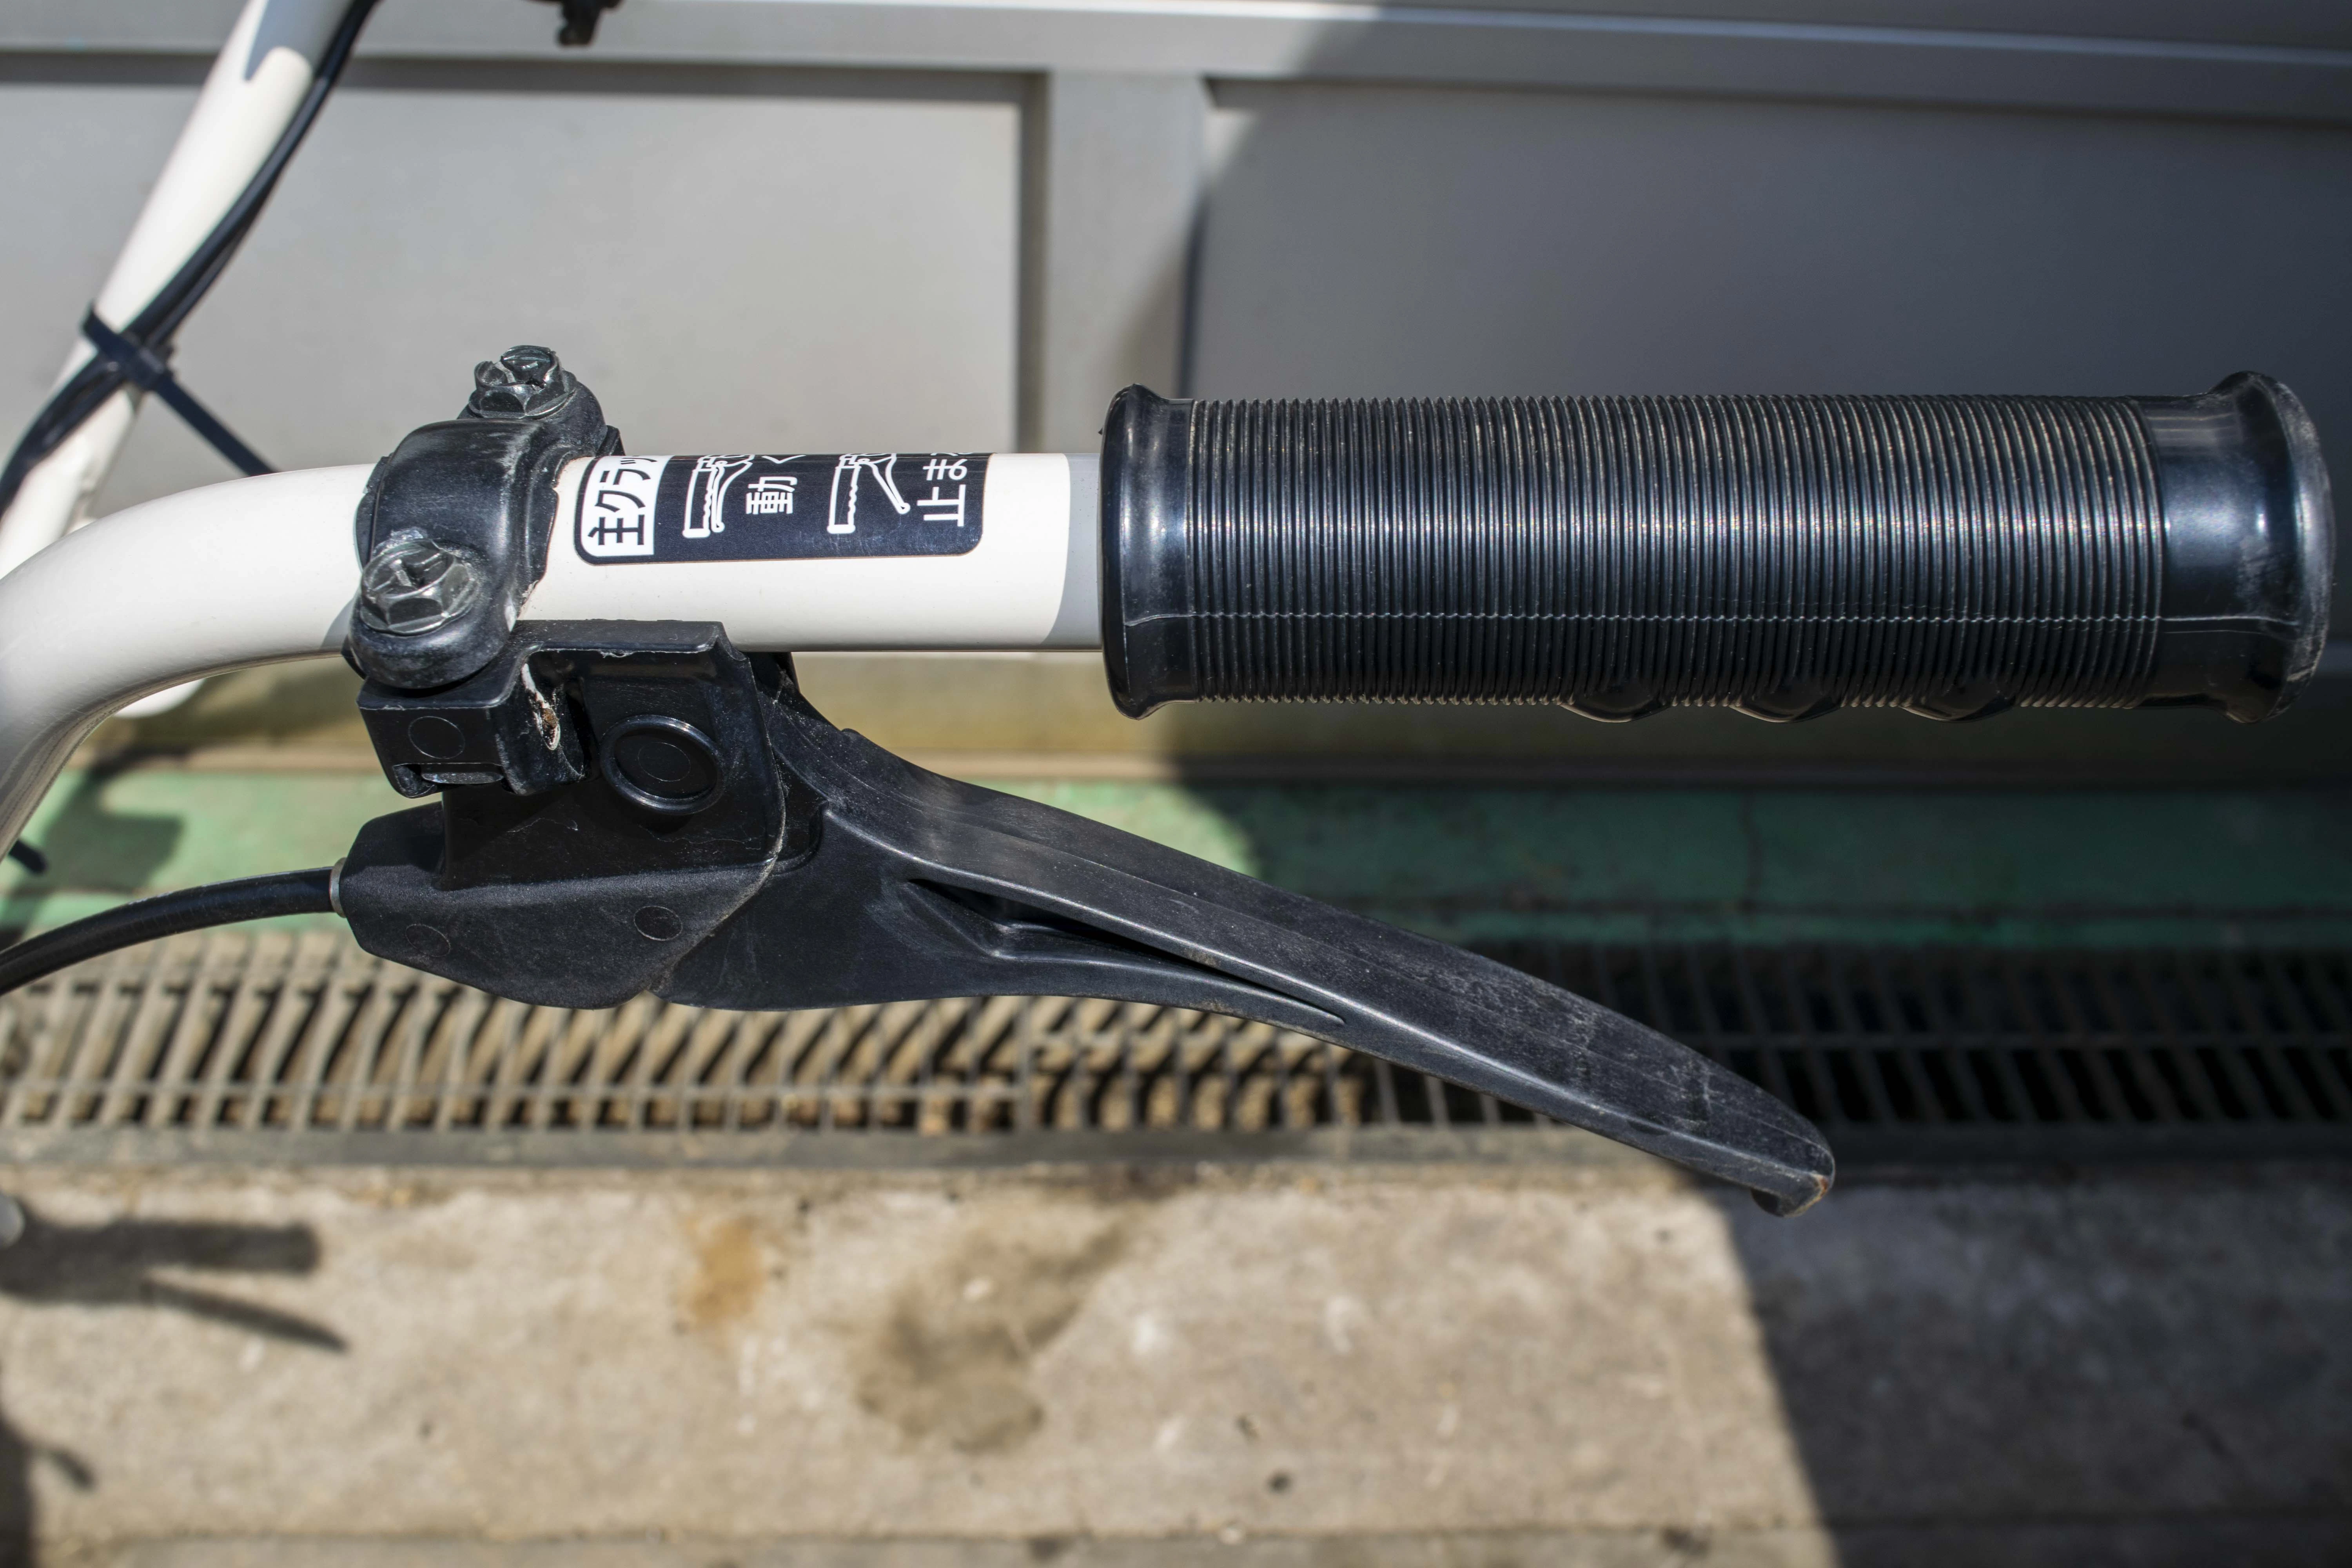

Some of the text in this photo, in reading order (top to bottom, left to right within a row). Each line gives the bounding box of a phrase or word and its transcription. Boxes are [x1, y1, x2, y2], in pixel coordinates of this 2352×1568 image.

[587, 455, 658, 546] 主クラッ
[746, 454, 806, 515] 動く
[916, 452, 973, 527] 止ま
